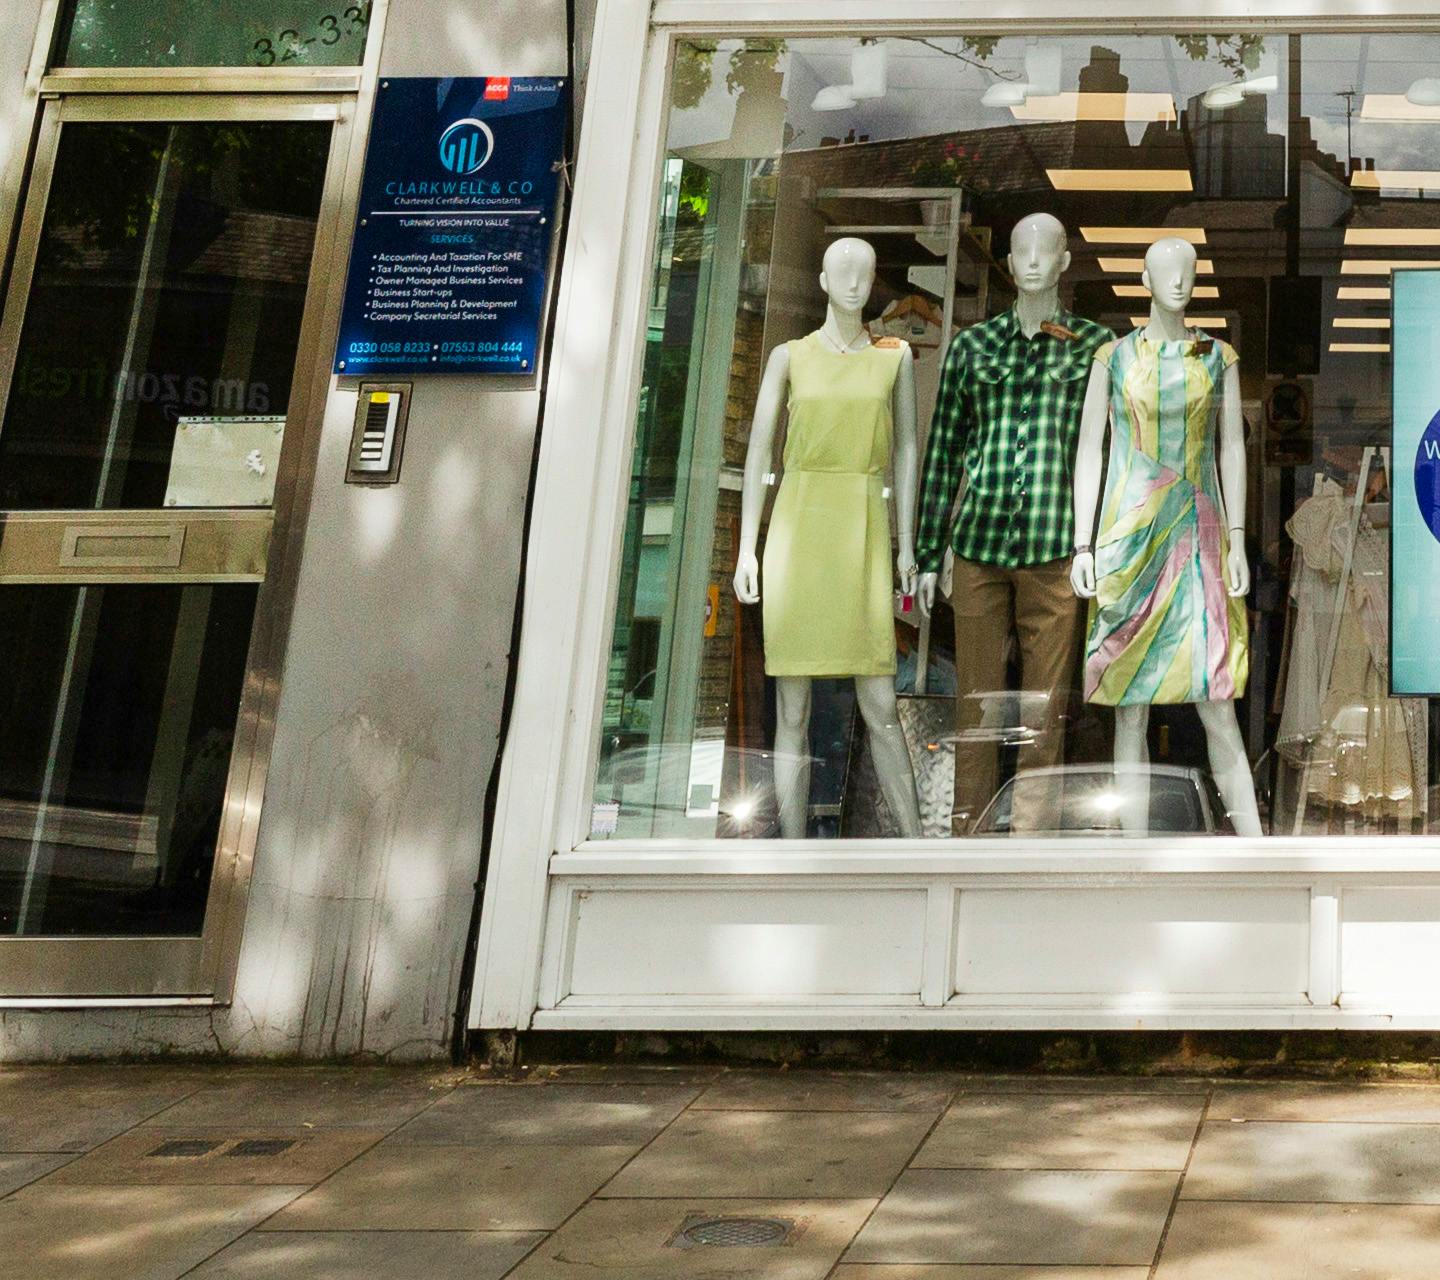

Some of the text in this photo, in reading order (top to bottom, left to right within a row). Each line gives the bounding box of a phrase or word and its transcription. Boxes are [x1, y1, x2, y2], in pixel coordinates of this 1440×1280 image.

[485, 84, 509, 92] ACCA
[534, 84, 556, 92] Ahead
[385, 181, 533, 195] CLARKWELL & CO
[394, 196, 521, 205] Chartered Certified Accountants
[399, 219, 435, 227] TURNING
[485, 218, 510, 226] VALUE
[431, 234, 474, 244] SERVICES
[378, 251, 523, 263] Accounting And Taxation For SME
[377, 264, 509, 274] Tax Planning And Investigation
[375, 276, 524, 287] Owner Managed Business Services
[373, 288, 453, 298] Business Start-ups
[371, 299, 518, 311] Business Planning & Development
[370, 311, 498, 323] Company Secretarial Services
[349, 341, 523, 353] 0330 058 8233 07553 804 444
